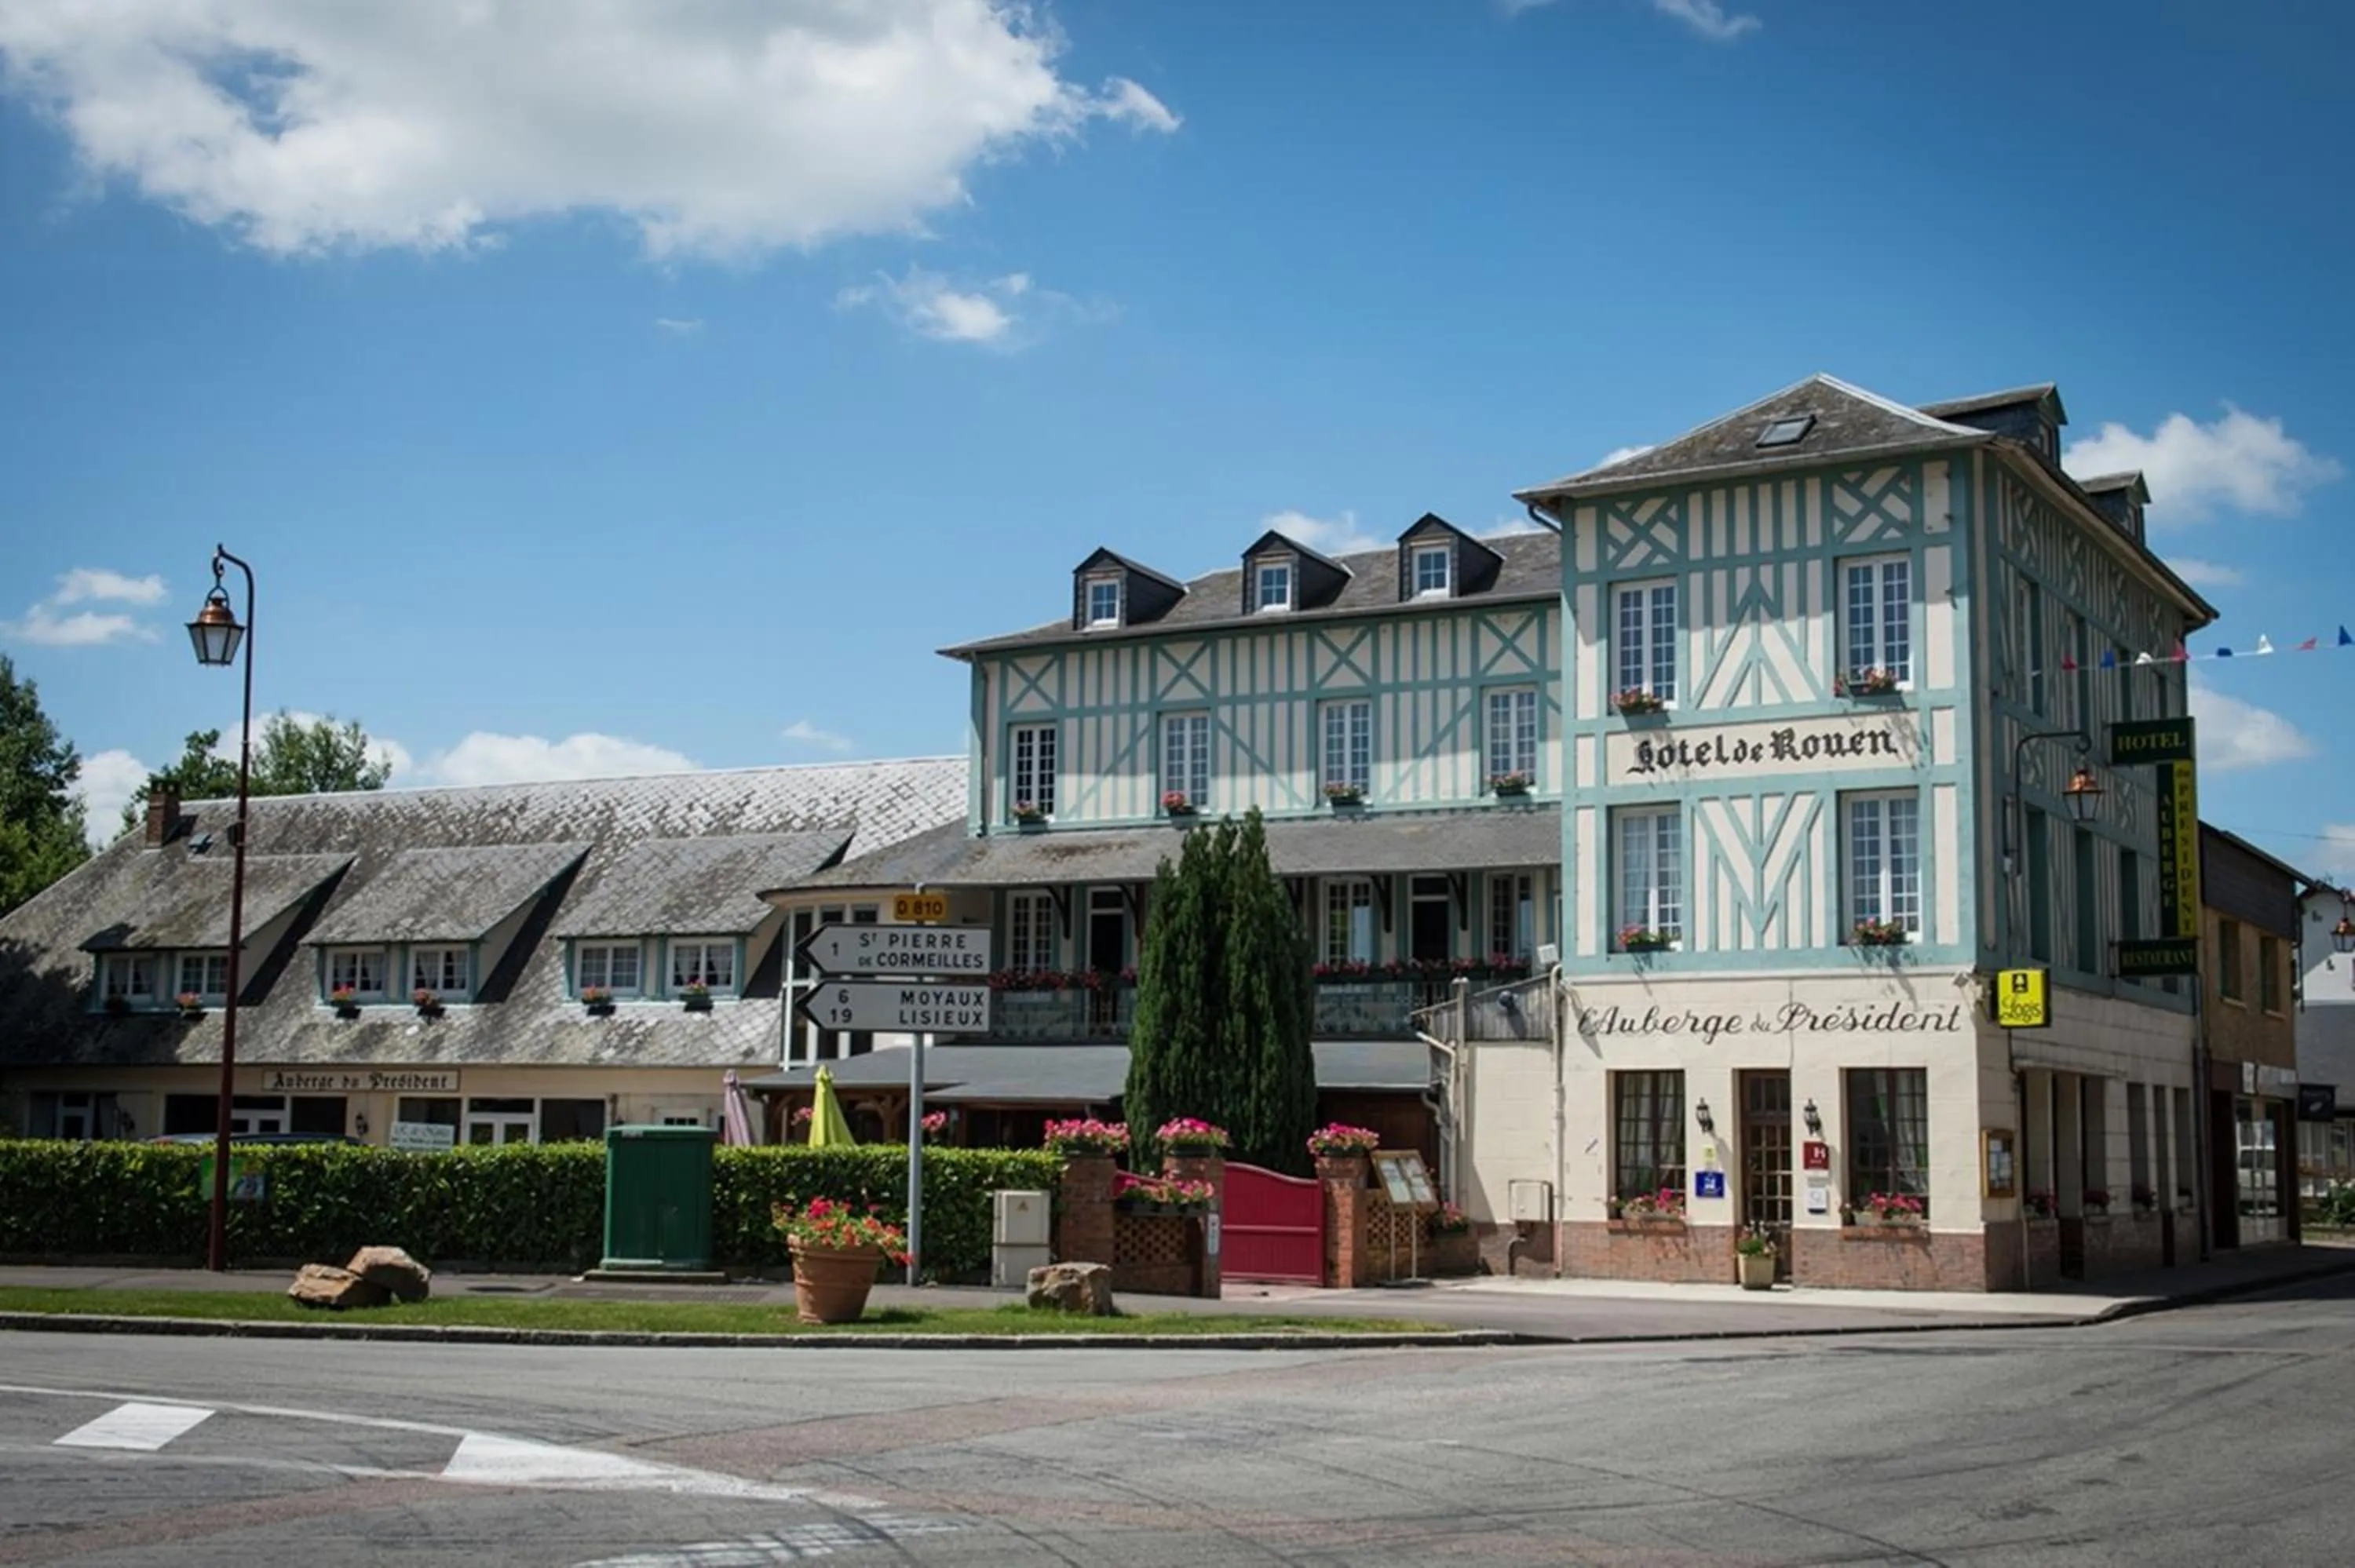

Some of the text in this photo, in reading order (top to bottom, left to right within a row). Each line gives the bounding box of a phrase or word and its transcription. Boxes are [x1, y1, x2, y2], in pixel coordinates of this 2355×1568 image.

[1770, 727, 1898, 761] Rouen
[2117, 731, 2186, 752] HOTEL
[896, 900, 943, 916] D 810
[831, 942, 839, 957] 1
[889, 933, 967, 949] PIERRE
[877, 952, 984, 968] CORMEILLES
[838, 989, 984, 1006] 6 MOYAUX
[830, 1008, 984, 1026] 19 LISIEUX
[1773, 1001, 1961, 1034] Président
